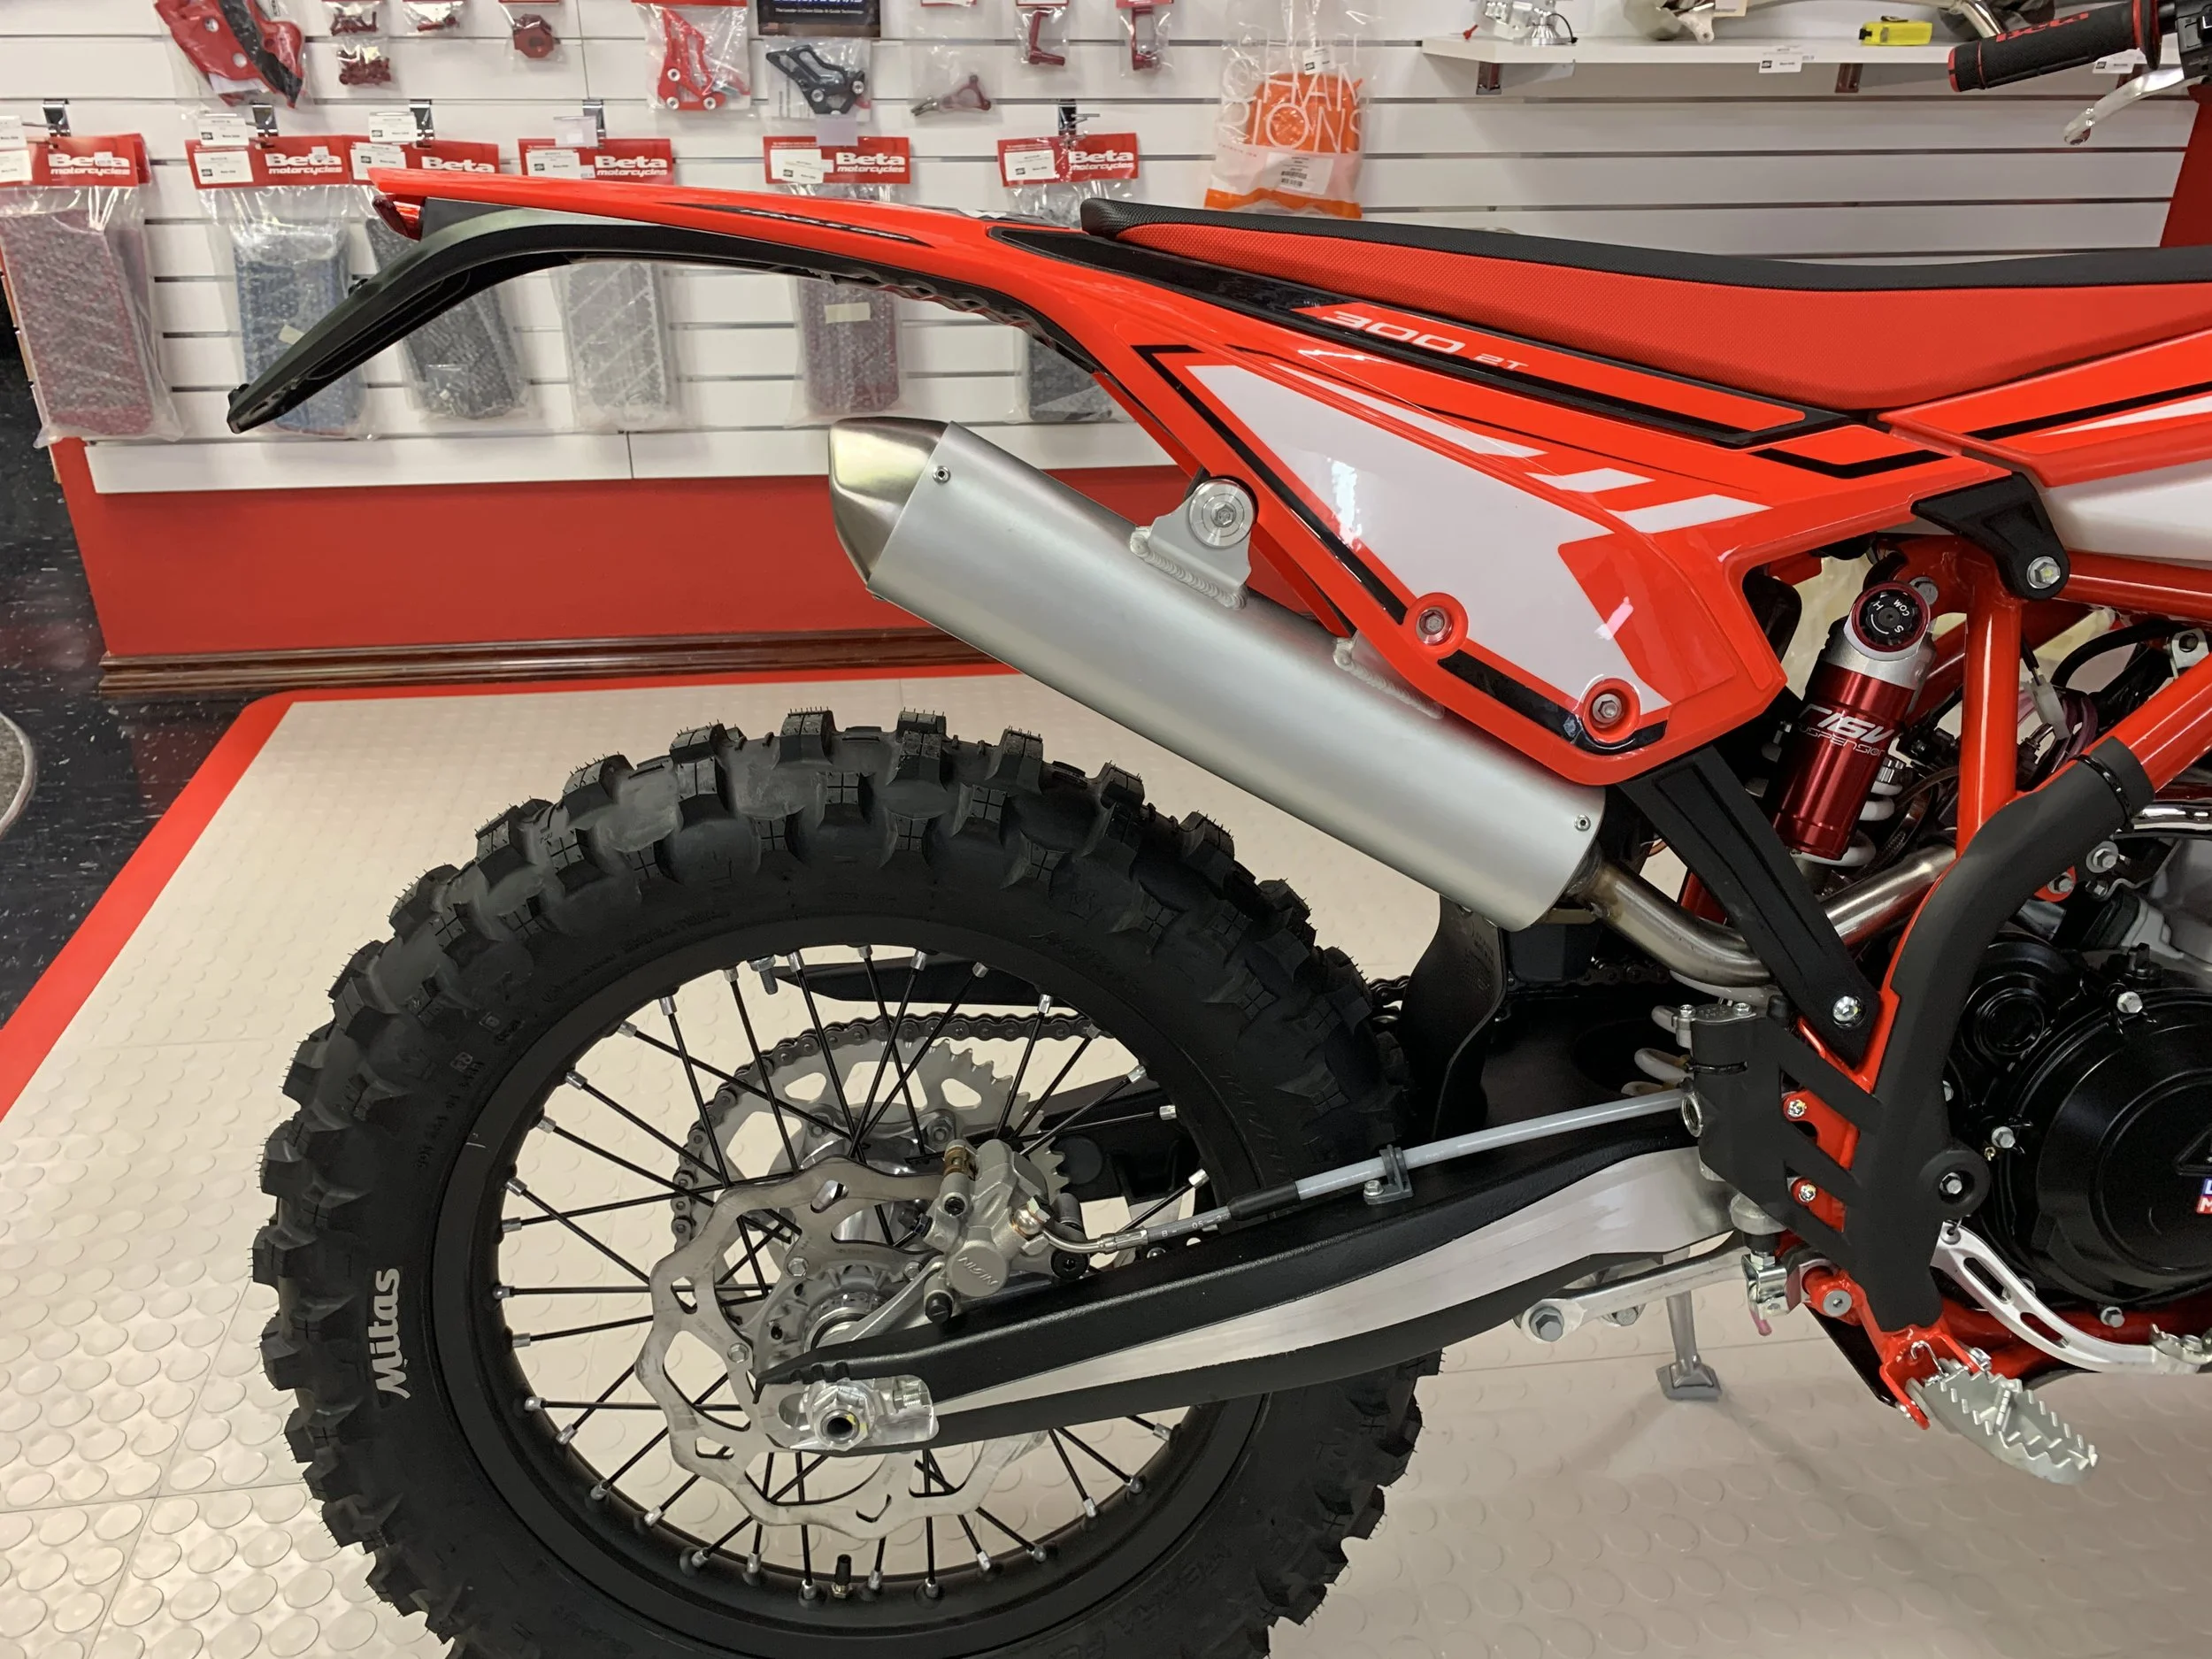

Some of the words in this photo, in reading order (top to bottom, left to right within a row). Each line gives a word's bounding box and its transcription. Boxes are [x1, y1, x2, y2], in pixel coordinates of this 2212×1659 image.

[48, 153, 131, 167] Bea
[595, 156, 668, 168] Beta
[836, 152, 906, 165] Beta
[1068, 150, 1134, 164] Beta
[268, 166, 343, 175] motorcycles
[421, 156, 495, 173] Beta
[837, 165, 906, 174] motorcycles
[50, 167, 131, 176] motorcycles
[1322, 311, 1466, 354] 300
[1471, 353, 1530, 370] 2T
[1872, 600, 1885, 611] H
[1893, 599, 1910, 617] COM
[1893, 625, 1904, 634] S
[367, 1268, 411, 1400] Mitas
